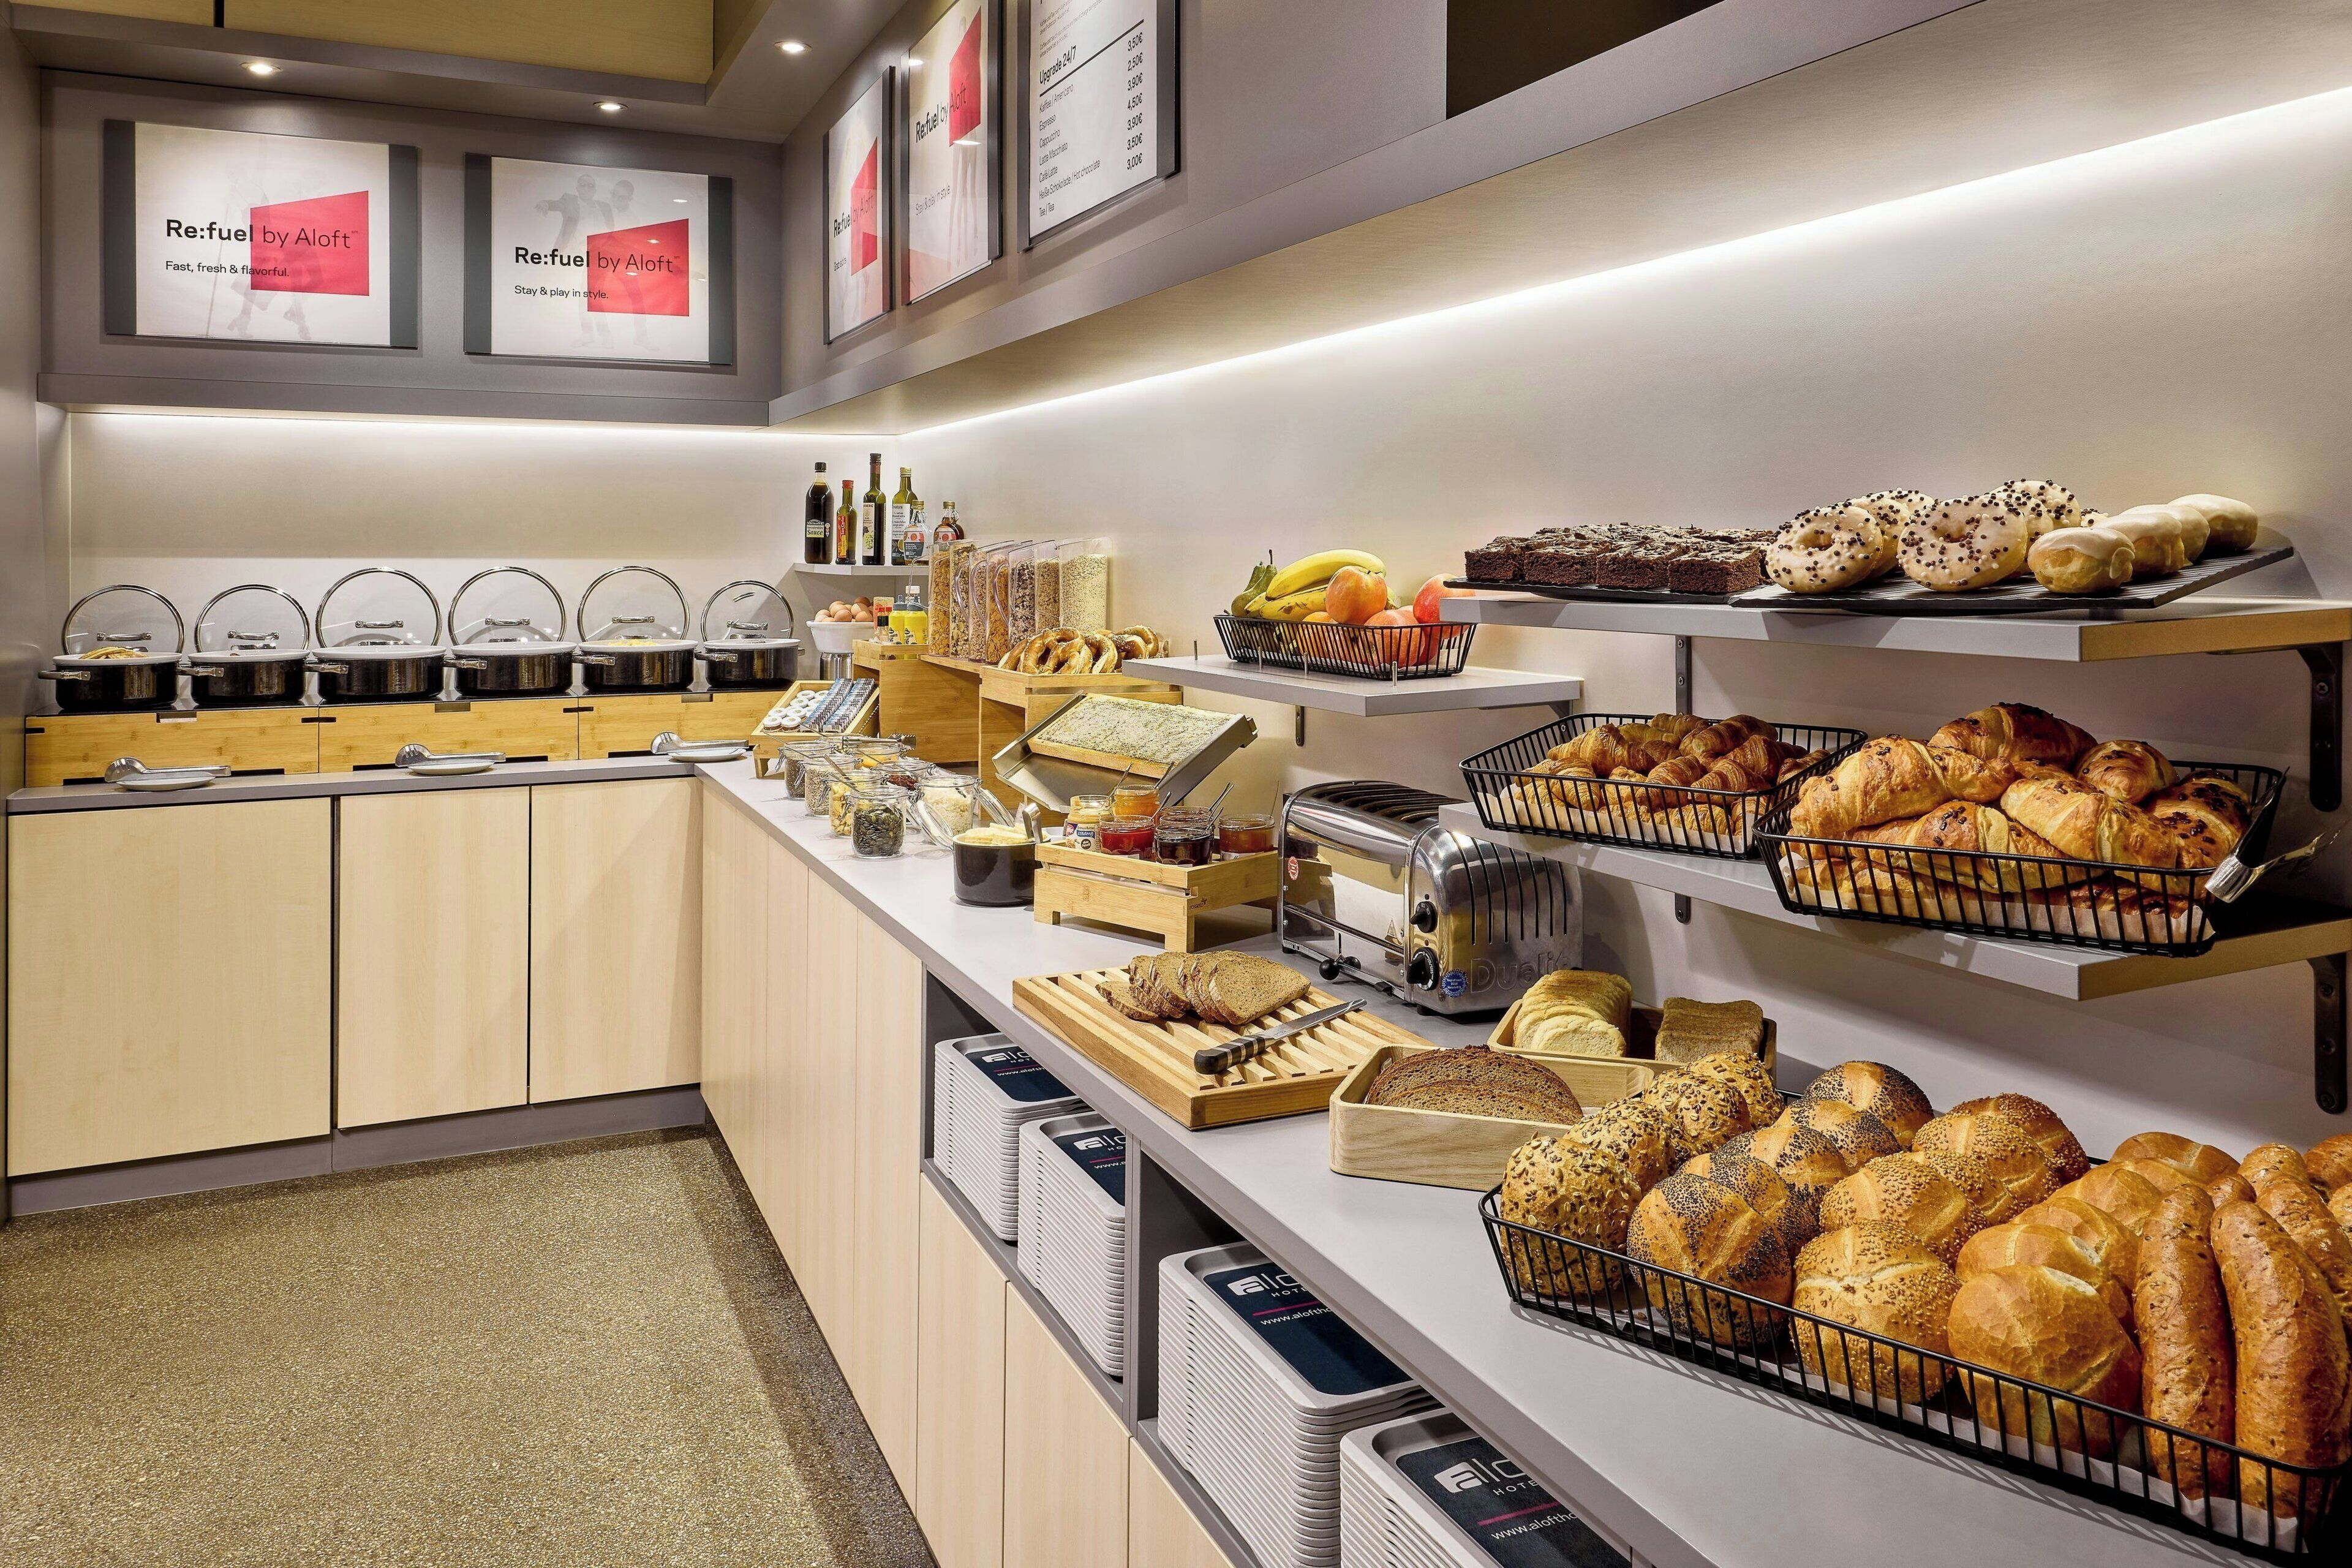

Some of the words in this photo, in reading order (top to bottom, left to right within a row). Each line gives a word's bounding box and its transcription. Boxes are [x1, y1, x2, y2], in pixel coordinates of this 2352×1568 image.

[1039, 99, 1051, 113] Kaffee
[1054, 85, 1073, 104] Americano
[1128, 32, 1142, 51] 3,50€
[1040, 58, 1061, 85] Upgrade
[1063, 45, 1076, 67] 24/7
[916, 104, 938, 143] Re:fuel
[941, 101, 948, 125] by
[949, 83, 966, 115] Aloft
[1039, 115, 1055, 131] Espresso
[1128, 52, 1143, 71] 2,50€
[1039, 129, 1060, 148] Cappuccino
[1128, 72, 1142, 91] 3,90€
[1039, 154, 1049, 165] Latte
[1049, 142, 1068, 159] Macchiato
[1128, 92, 1142, 111] 4,50€
[1049, 166, 1057, 178] Latte
[1128, 113, 1142, 130] 3,90€
[1127, 133, 1142, 150] 3,50€
[1127, 153, 1142, 170] 3,00€
[167, 219, 253, 242] Re:fuel
[263, 225, 289, 247] by
[295, 228, 350, 248] Aloft
[834, 206, 852, 238] Re:fuel
[860, 190, 873, 215] Aloft
[166, 261, 194, 273] Fast,
[197, 262, 227, 273] fresh
[230, 265, 238, 274] &
[241, 266, 289, 277] flavorful.
[515, 247, 590, 267] Re:fuel
[598, 252, 620, 273] by
[626, 254, 673, 273] Aloft
[514, 285, 538, 296] Stay
[540, 287, 548, 295] &
[551, 288, 570, 298] play
[573, 288, 580, 297] in
[583, 290, 608, 299] style.
